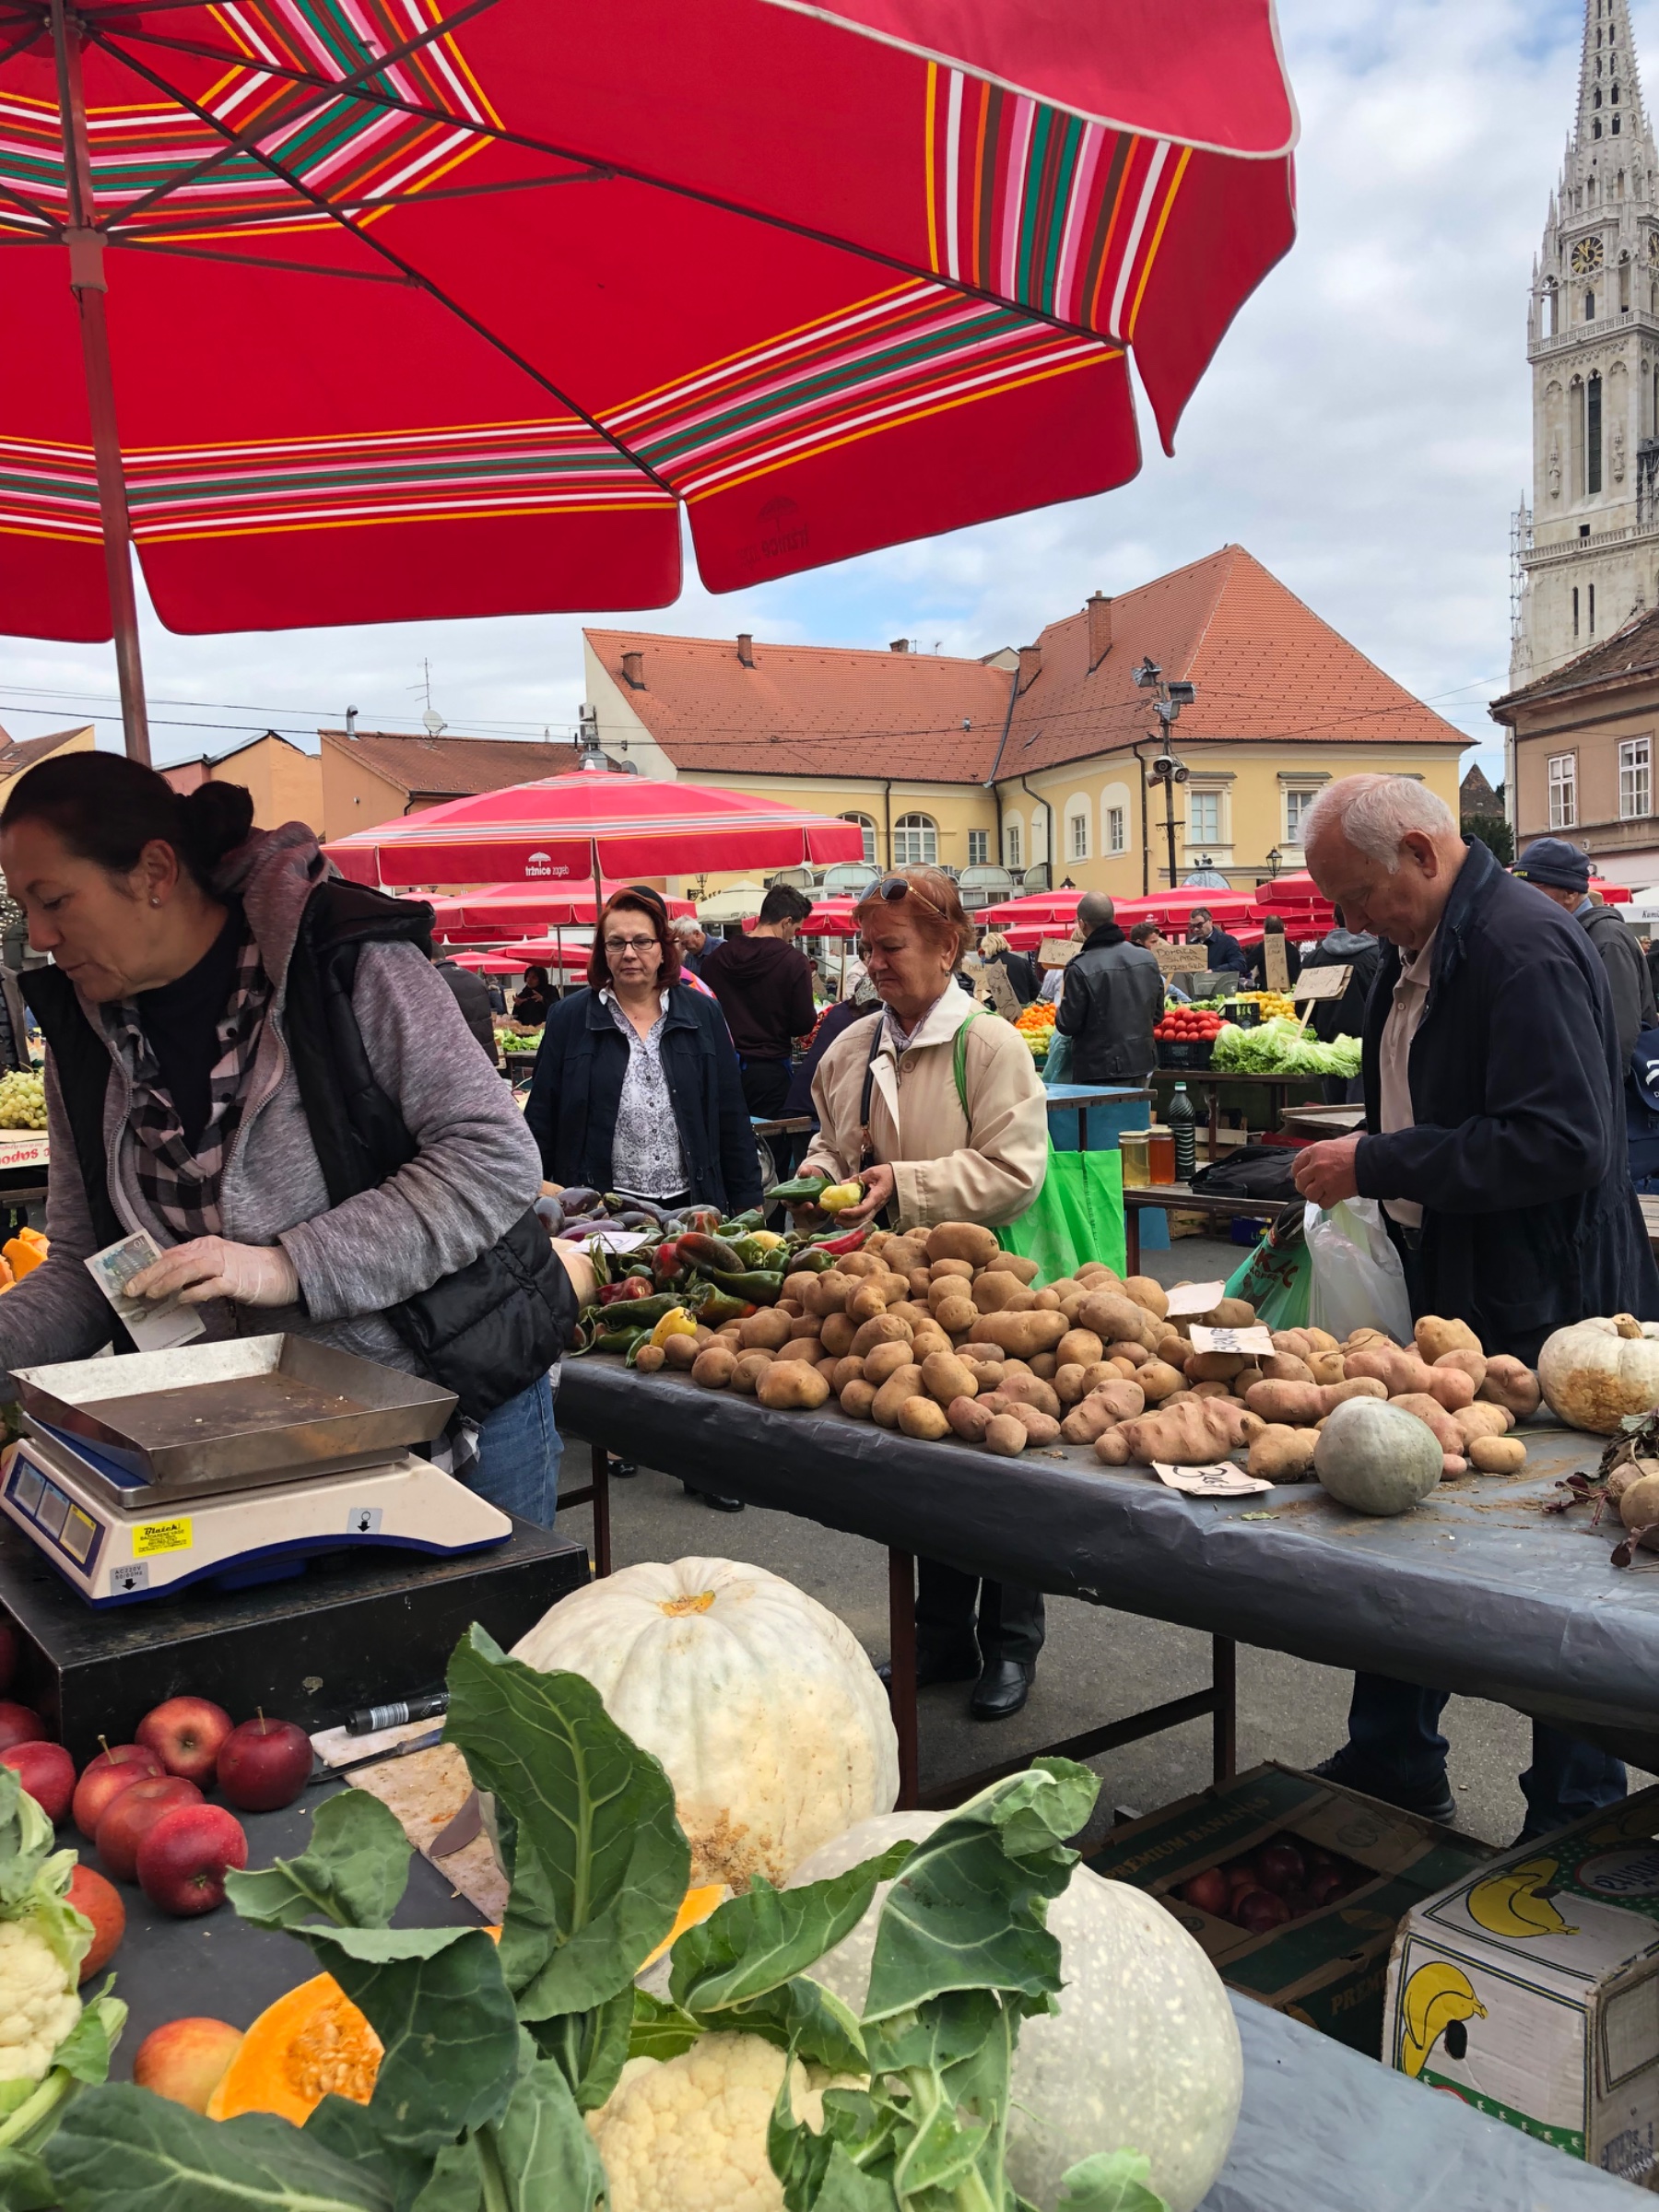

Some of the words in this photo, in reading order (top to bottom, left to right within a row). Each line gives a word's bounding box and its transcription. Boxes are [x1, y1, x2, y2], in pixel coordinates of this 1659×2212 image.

[0, 1147, 39, 1166] sapo
[1102, 1836, 1189, 1880] PREMIUM
[1185, 1797, 1271, 1841] BANANAS
